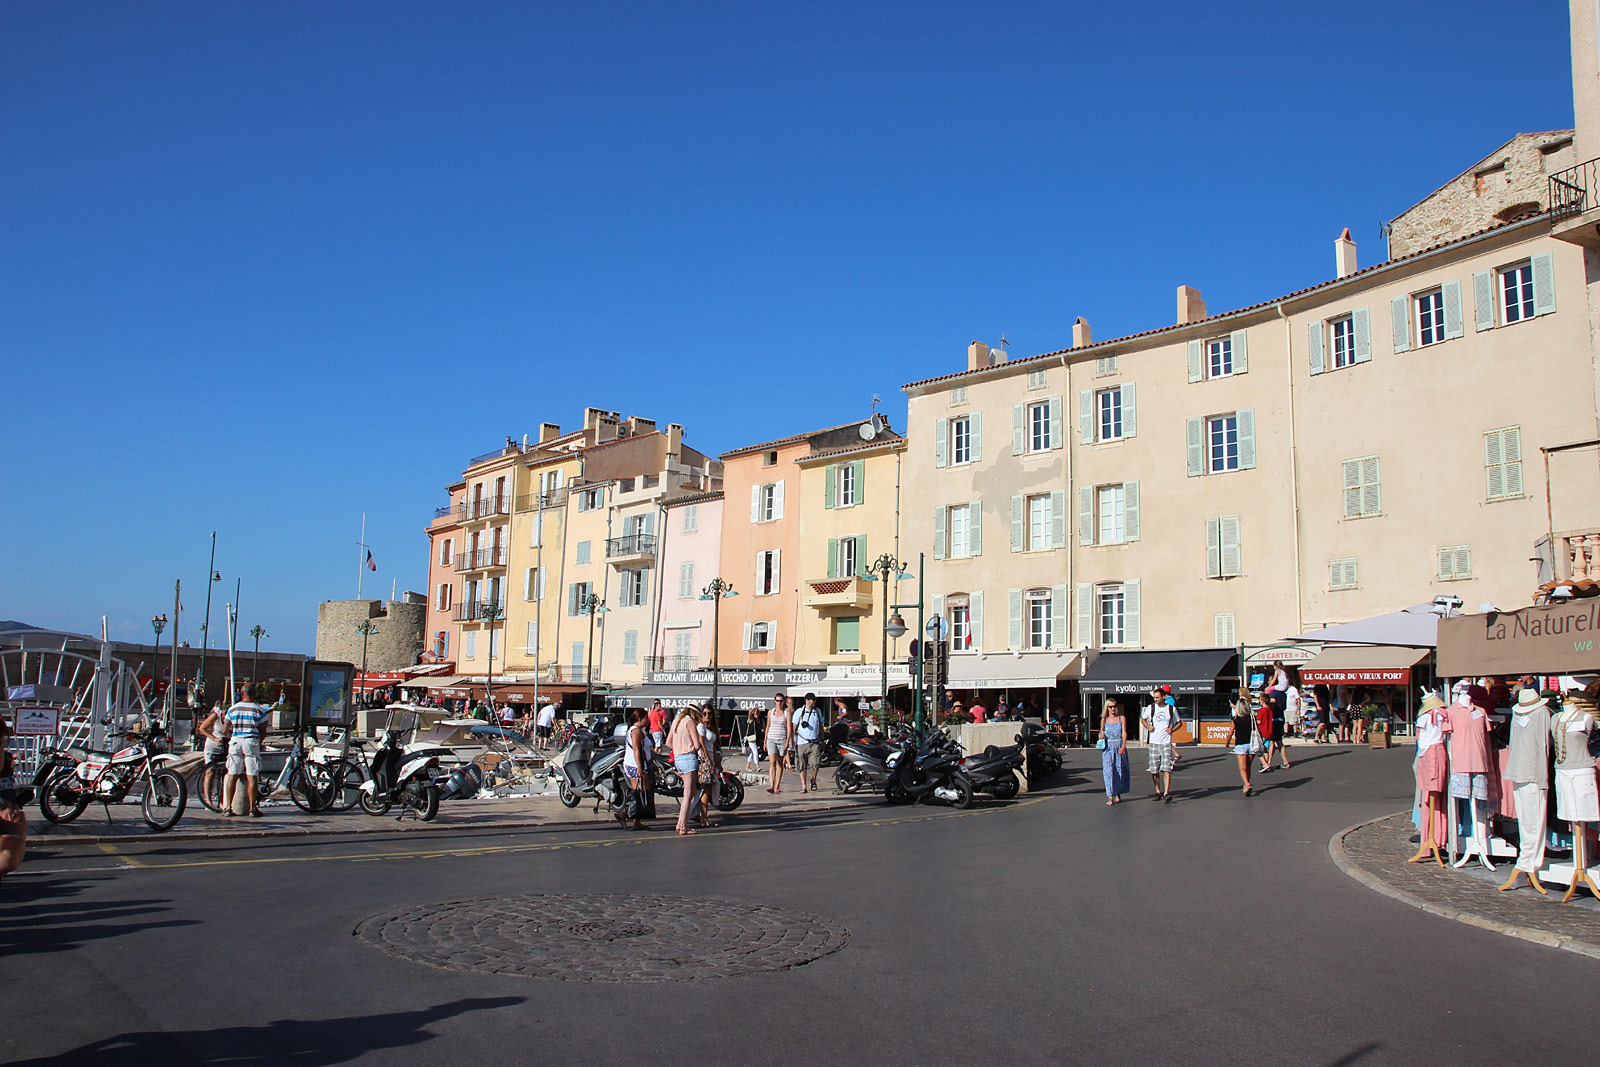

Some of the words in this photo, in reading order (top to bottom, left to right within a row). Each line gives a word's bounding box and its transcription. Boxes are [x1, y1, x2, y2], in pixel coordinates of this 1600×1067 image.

[1486, 613, 1506, 640] La
[1573, 640, 1593, 652] we
[1300, 651, 1309, 659] 2€
[653, 672, 687, 682] RISTORANTE
[721, 673, 748, 683] VECCHIO
[751, 674, 774, 683] PORTO
[785, 673, 819, 683] PIZZERIA
[1303, 673, 1315, 681] LE
[1315, 673, 1346, 681] GLACIER
[1358, 672, 1382, 680] VIEUX
[1382, 672, 1404, 680] PORT
[1115, 684, 1137, 694] kyoto
[740, 700, 766, 709] GLACES
